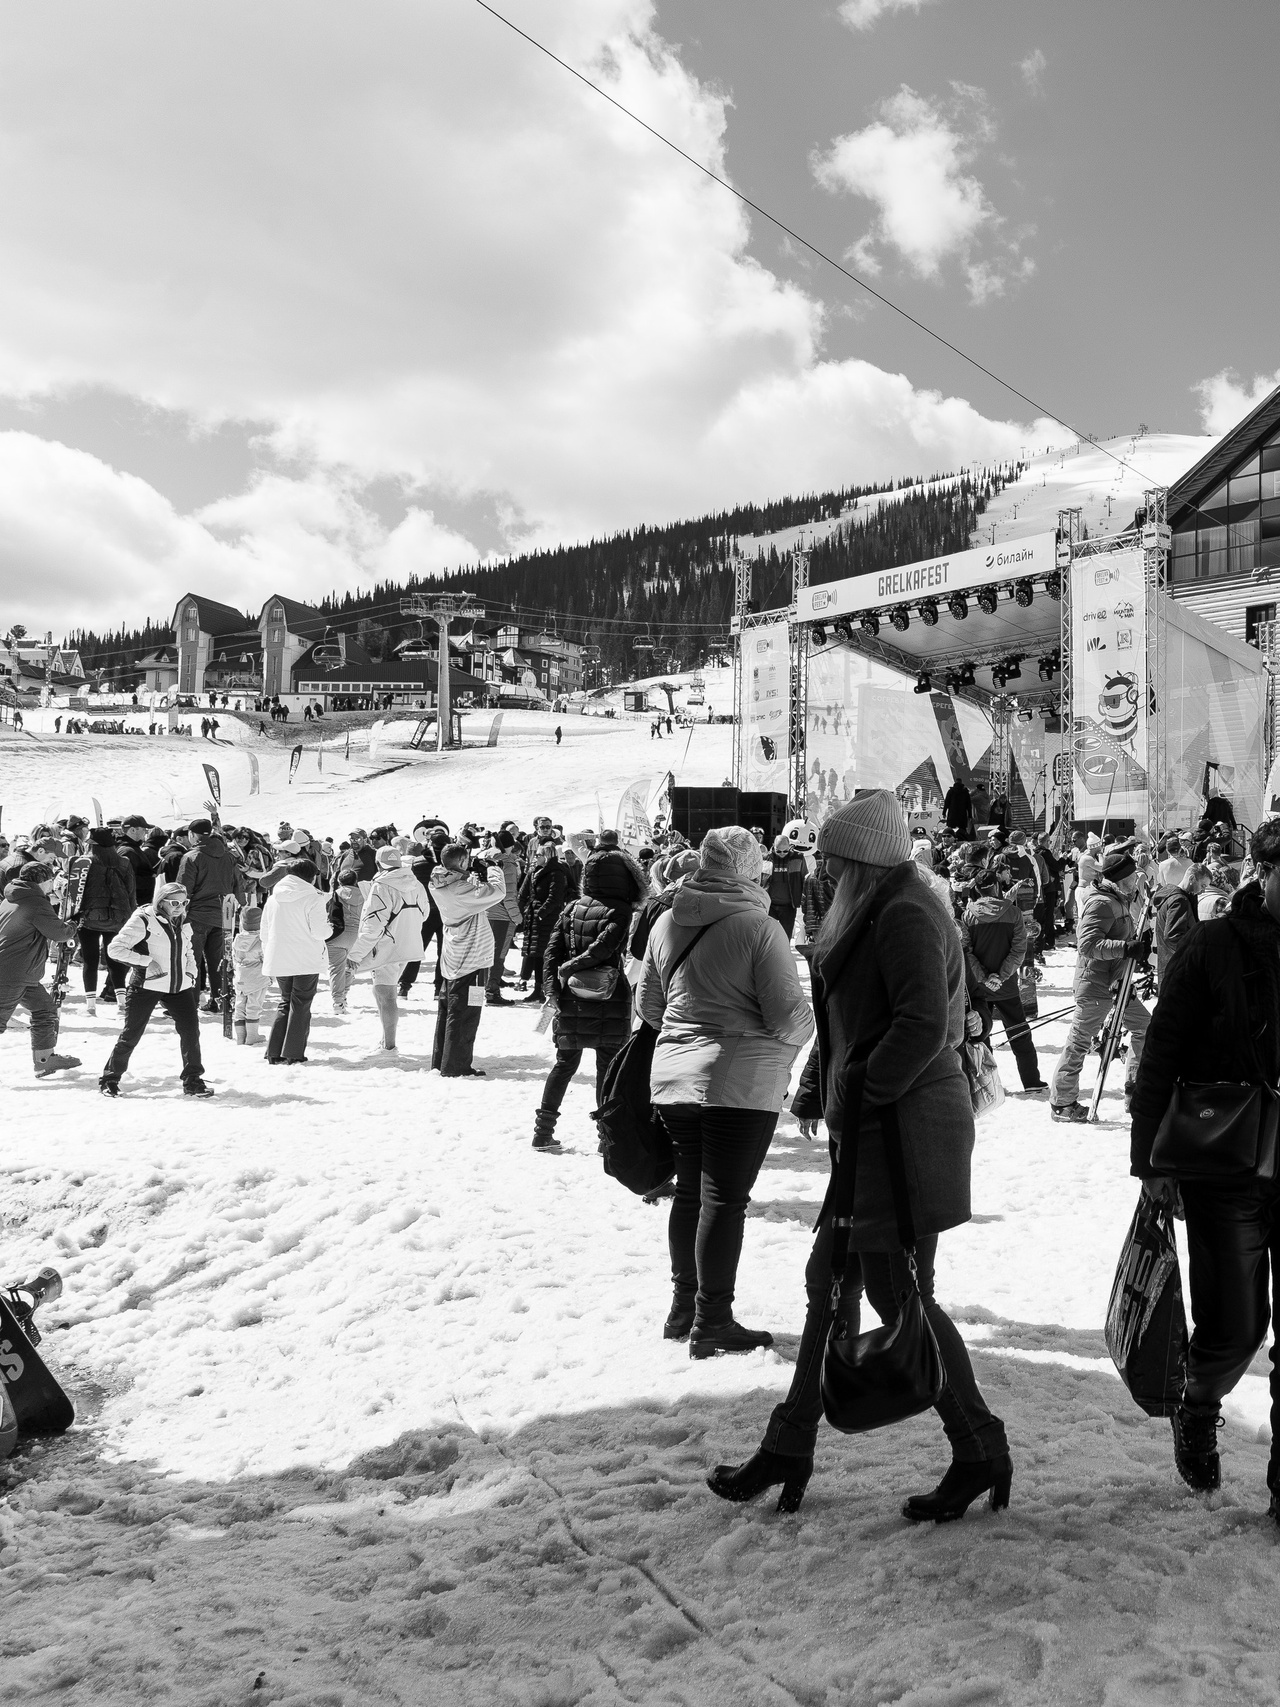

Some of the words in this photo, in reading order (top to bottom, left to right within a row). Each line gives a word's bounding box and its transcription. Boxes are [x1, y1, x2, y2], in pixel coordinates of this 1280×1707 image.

[996, 548, 1034, 566] билайн
[877, 561, 950, 597] GRELKAFEST
[1083, 610, 1107, 621] drivee
